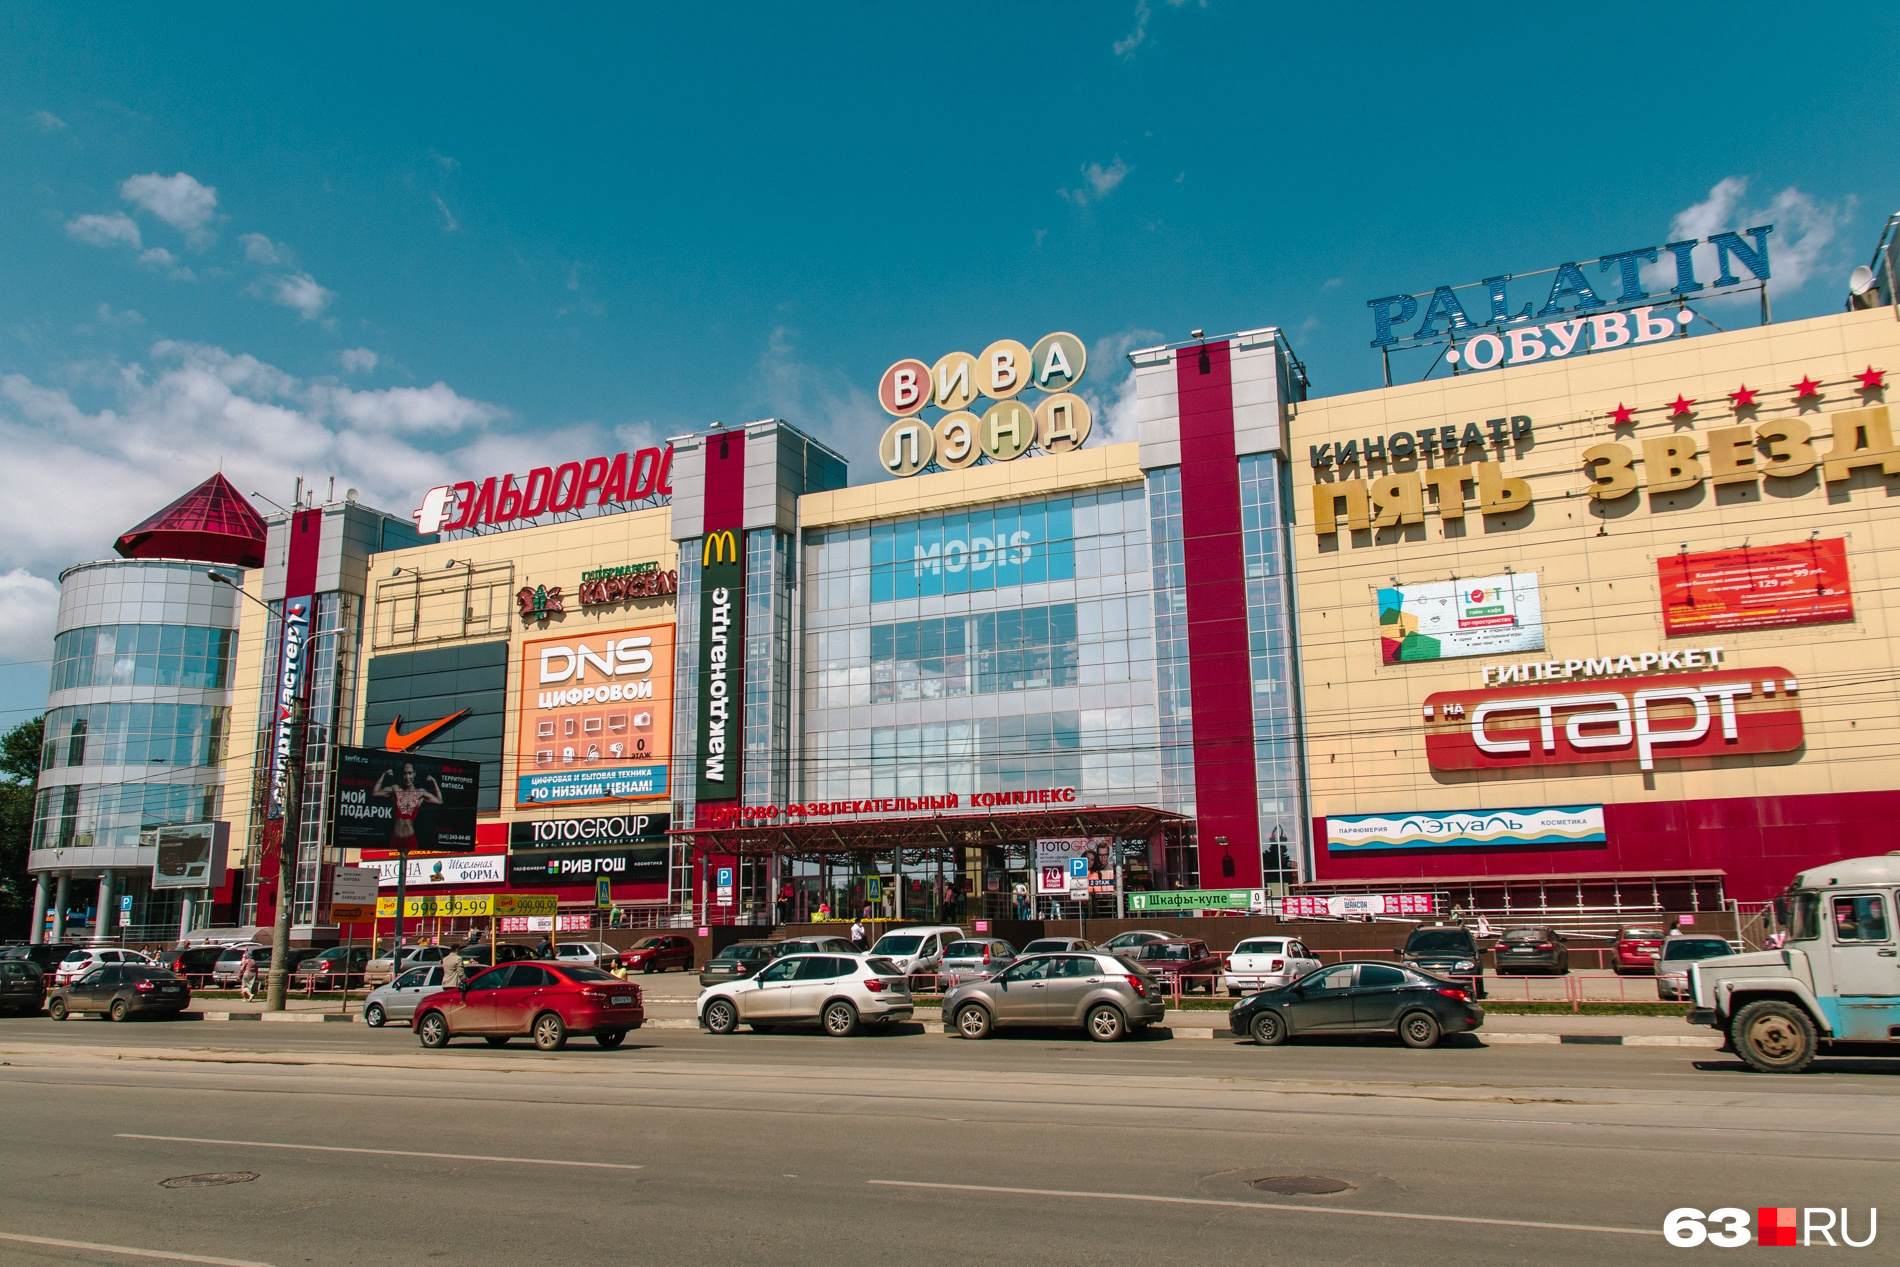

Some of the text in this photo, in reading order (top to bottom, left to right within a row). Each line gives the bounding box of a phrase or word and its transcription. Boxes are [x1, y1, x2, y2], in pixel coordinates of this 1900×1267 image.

[1367, 225, 1774, 348] PALATIN
[1464, 306, 1677, 370] ОБУВЬ
[894, 342, 1073, 407] ВИВА
[888, 400, 1078, 468] ЛЭНД
[1310, 414, 1533, 468] КИНОТЕАТР
[1313, 406, 1900, 535] ПЯТЬ ЗВЕЗД
[914, 530, 1032, 577] MODIS
[582, 561, 659, 581] ГИПЕРМАРКЕТ
[1794, 568, 1809, 578] 99
[1757, 579, 1779, 589] 129
[540, 636, 654, 684] DNS
[1482, 646, 1725, 684] ГИПЕРМАРКЕТ
[705, 587, 731, 782] Макдоналдс
[538, 678, 653, 710] ЦИФРОВОЙ
[1443, 703, 1465, 715] НА
[636, 738, 645, 751] 0
[441, 774, 473, 784] ТЕРРИТОРИЯ
[531, 769, 652, 785] ЦИФРОВАЯ И БЫТОВАЯ ТЕХНИКА
[441, 782, 464, 790] ФИТНЕСА
[531, 779, 653, 799] ПО НИЗКИМ ЦЕНАМ!
[341, 789, 366, 804] МОЙ
[970, 787, 1076, 807] КОМПЛЕКС
[340, 804, 392, 819] ПОДАРОК
[531, 815, 650, 841] TOTOGROUP
[1339, 826, 1388, 834] ПАРФЮМЕРИЯ
[1540, 817, 1588, 827] КОСМЕТИКА
[448, 858, 493, 870] Школьная
[561, 859, 592, 874] РИВ
[594, 857, 626, 872] ГОШ
[1073, 860, 1084, 875] P
[460, 869, 499, 880] ФОРМА
[720, 870, 729, 884] P
[1149, 894, 1228, 906] Шкафы-купе
[1254, 892, 1260, 902] 0
[411, 901, 487, 916] 999-99-99
